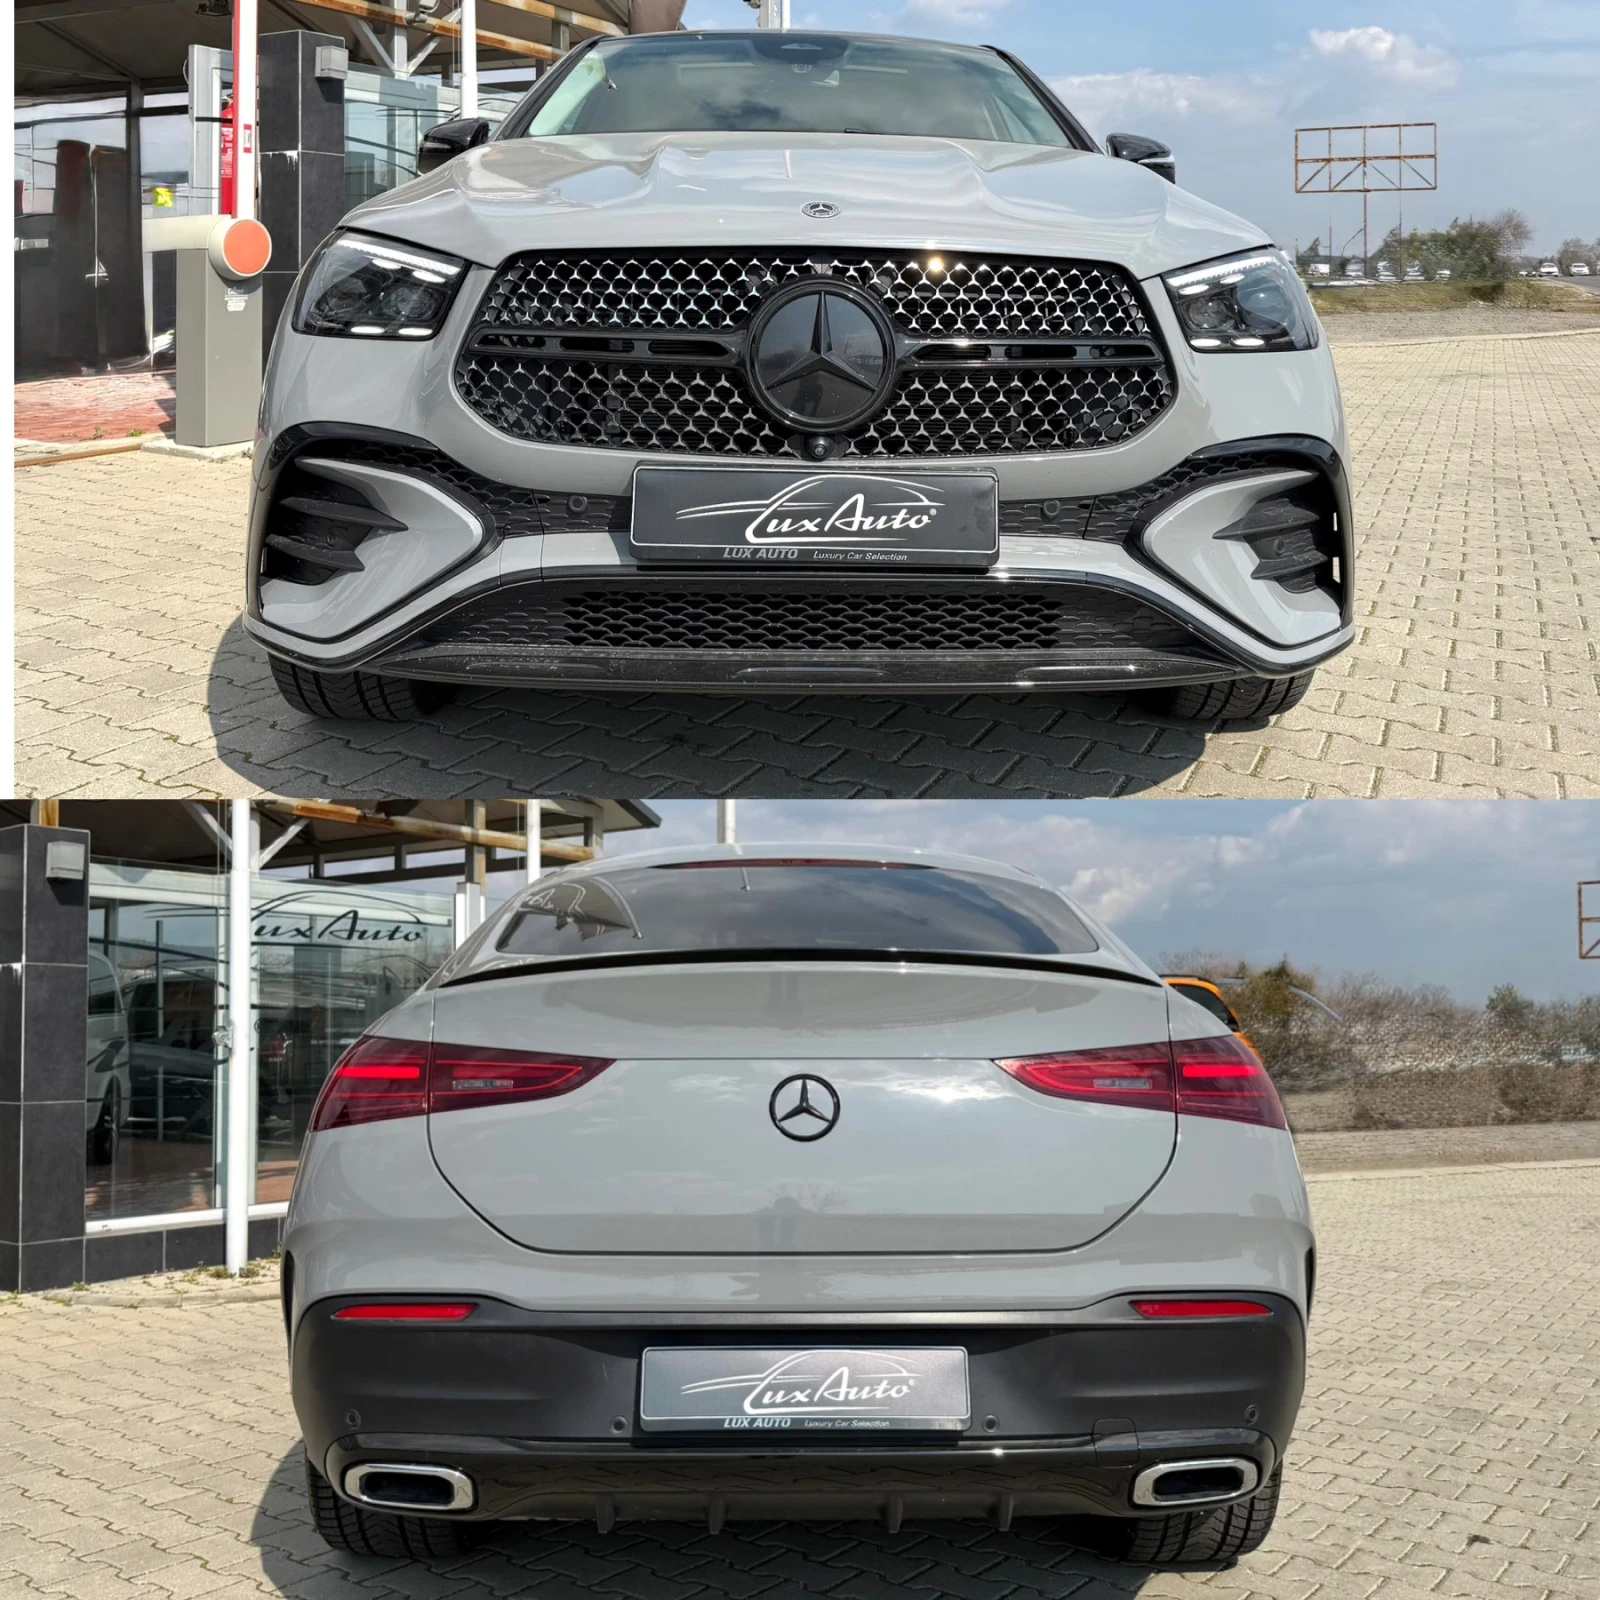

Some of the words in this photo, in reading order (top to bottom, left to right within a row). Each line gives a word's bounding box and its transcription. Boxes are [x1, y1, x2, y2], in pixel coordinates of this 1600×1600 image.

[723, 547, 753, 559] LUX
[755, 548, 798, 559] AUTO
[813, 550, 845, 561] Luxury
[847, 551, 863, 560] Car
[865, 552, 908, 561] Selection
[723, 1417, 750, 1428] LUX
[752, 1418, 791, 1428] AUTO
[804, 1419, 832, 1429] Luxury
[834, 1419, 849, 1428] Car
[850, 1419, 890, 1428] Selection
